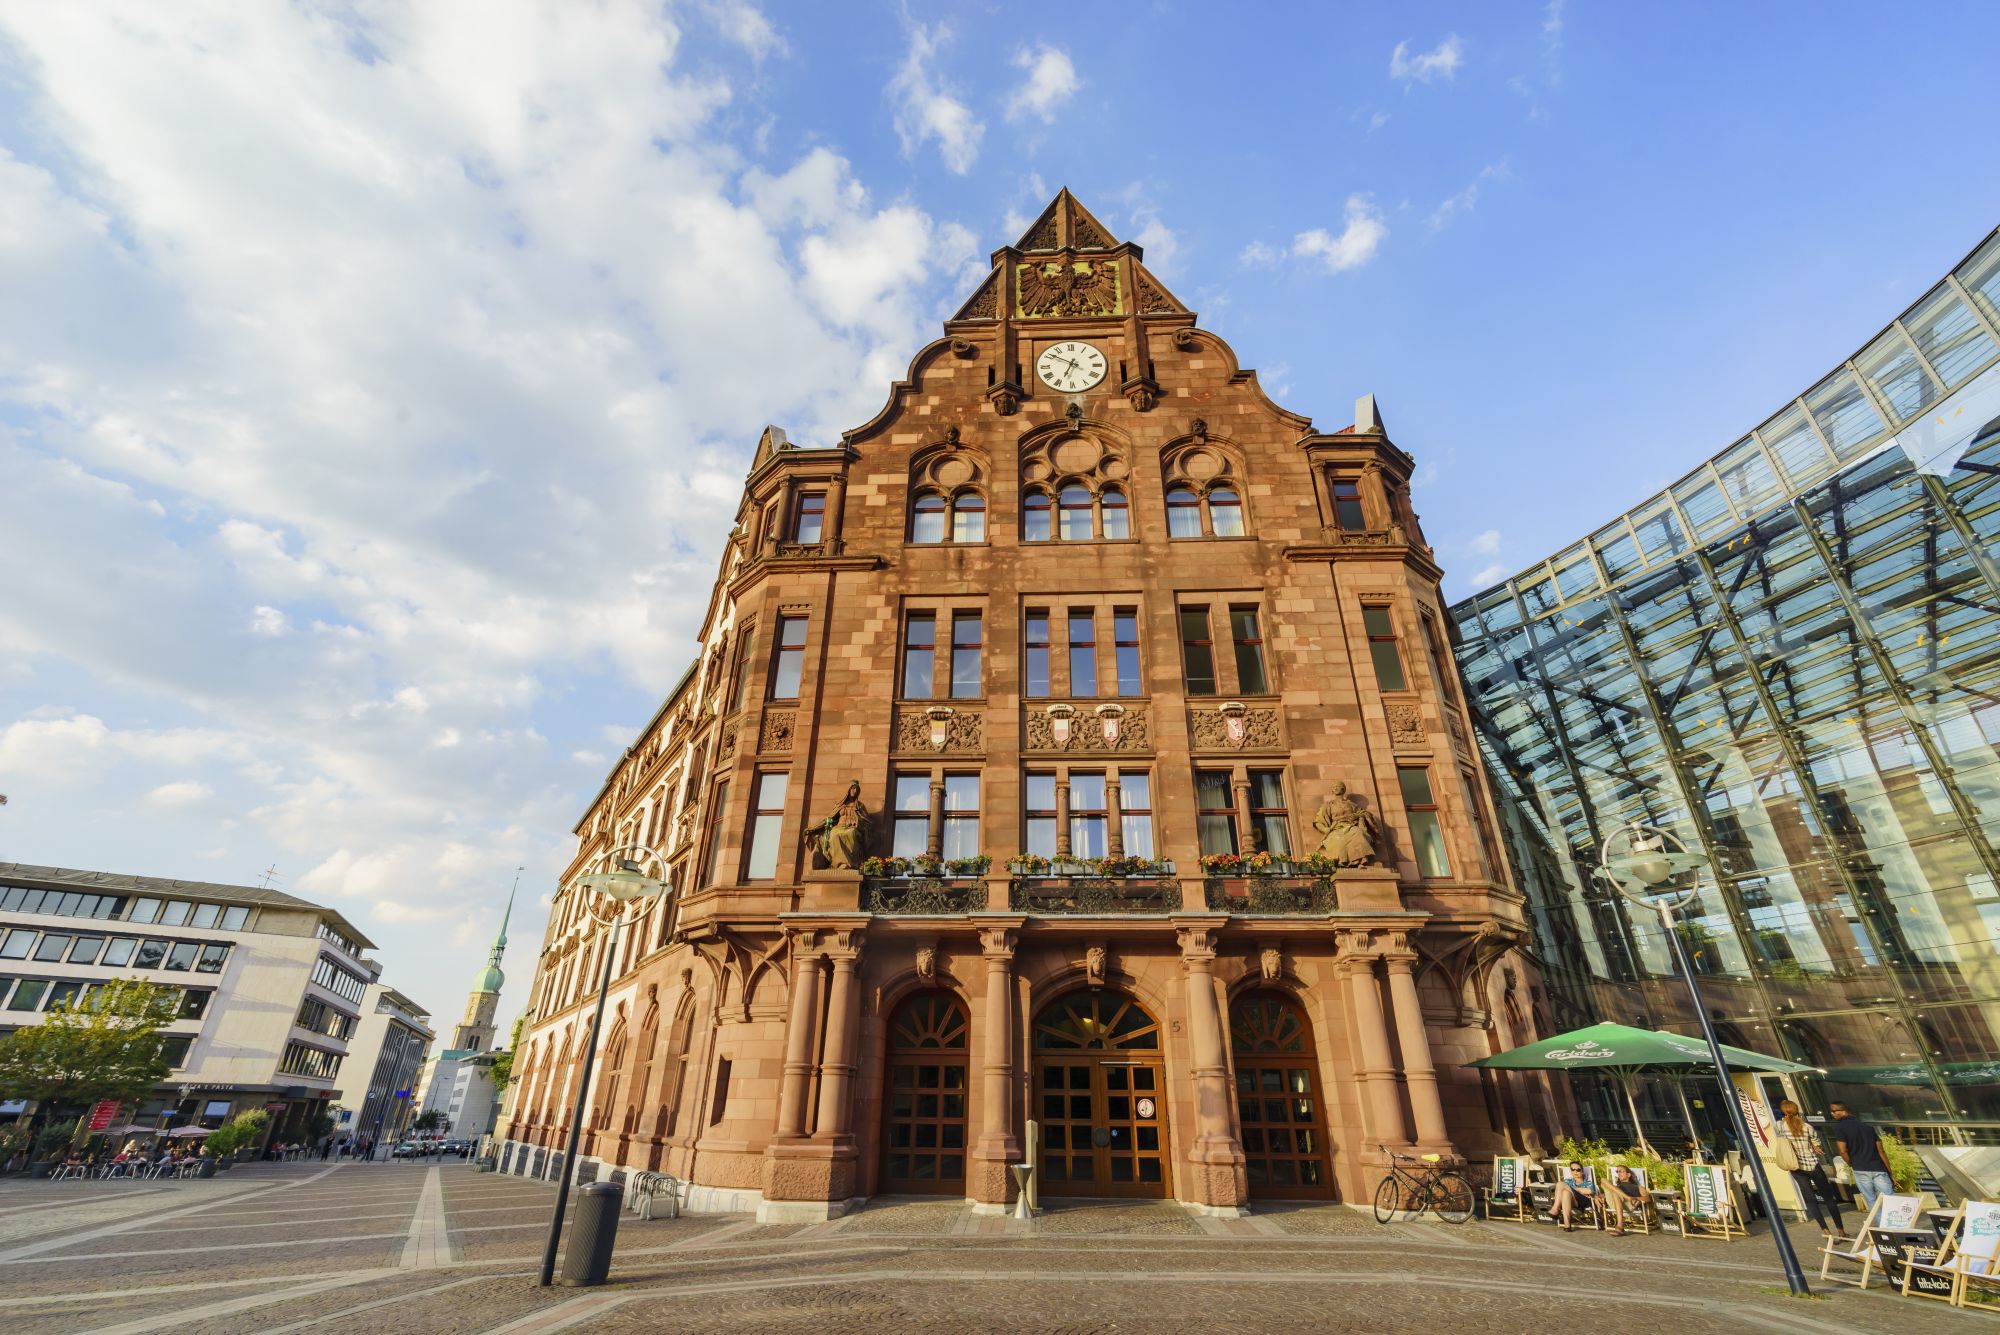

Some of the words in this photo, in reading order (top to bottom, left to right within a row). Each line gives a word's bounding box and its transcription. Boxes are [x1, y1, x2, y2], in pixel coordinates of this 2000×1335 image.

[1172, 1020, 1181, 1032] 5
[1545, 1048, 1616, 1061] Carlsberg
[1916, 1276, 1951, 1290] fritz-kola
